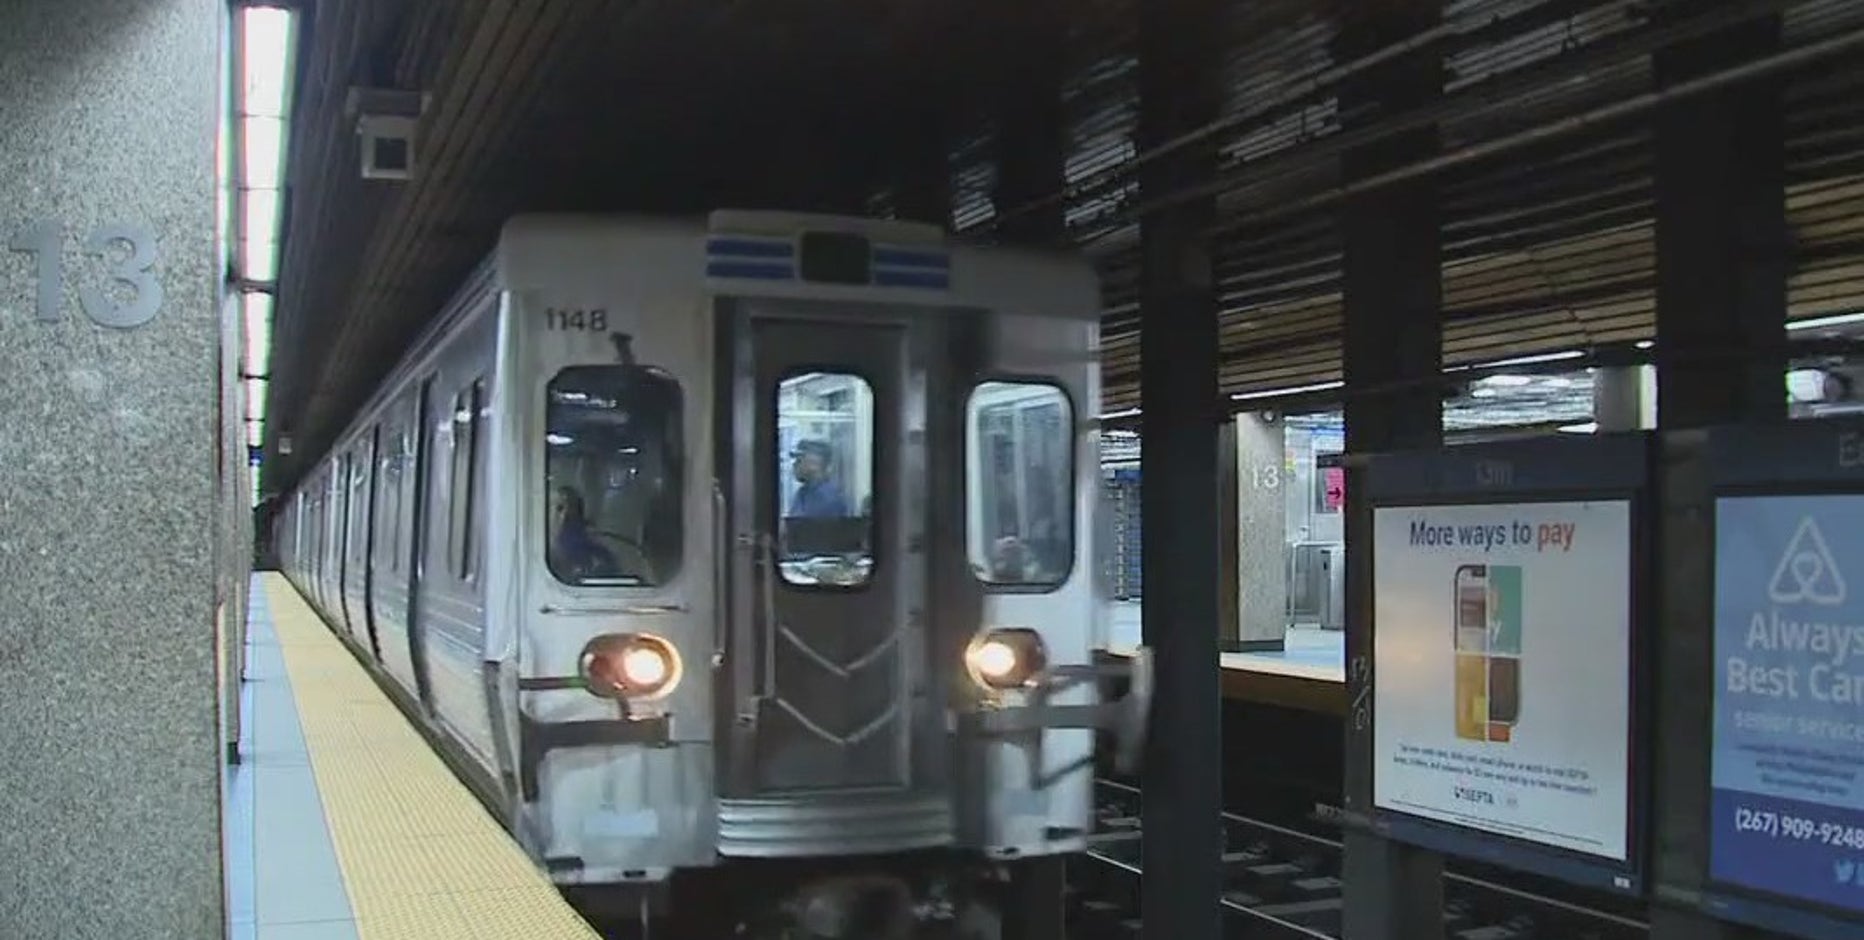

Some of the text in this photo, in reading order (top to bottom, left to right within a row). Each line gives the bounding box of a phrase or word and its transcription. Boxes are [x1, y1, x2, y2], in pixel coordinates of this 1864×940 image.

[8, 218, 163, 329] 13
[544, 307, 607, 332] 1148
[1253, 464, 1279, 488] 13
[1410, 520, 1575, 552] More ways to pay
[1745, 611, 1864, 666] Always
[1727, 657, 1799, 698] Best
[1735, 808, 1864, 849] (267) 909-9248
